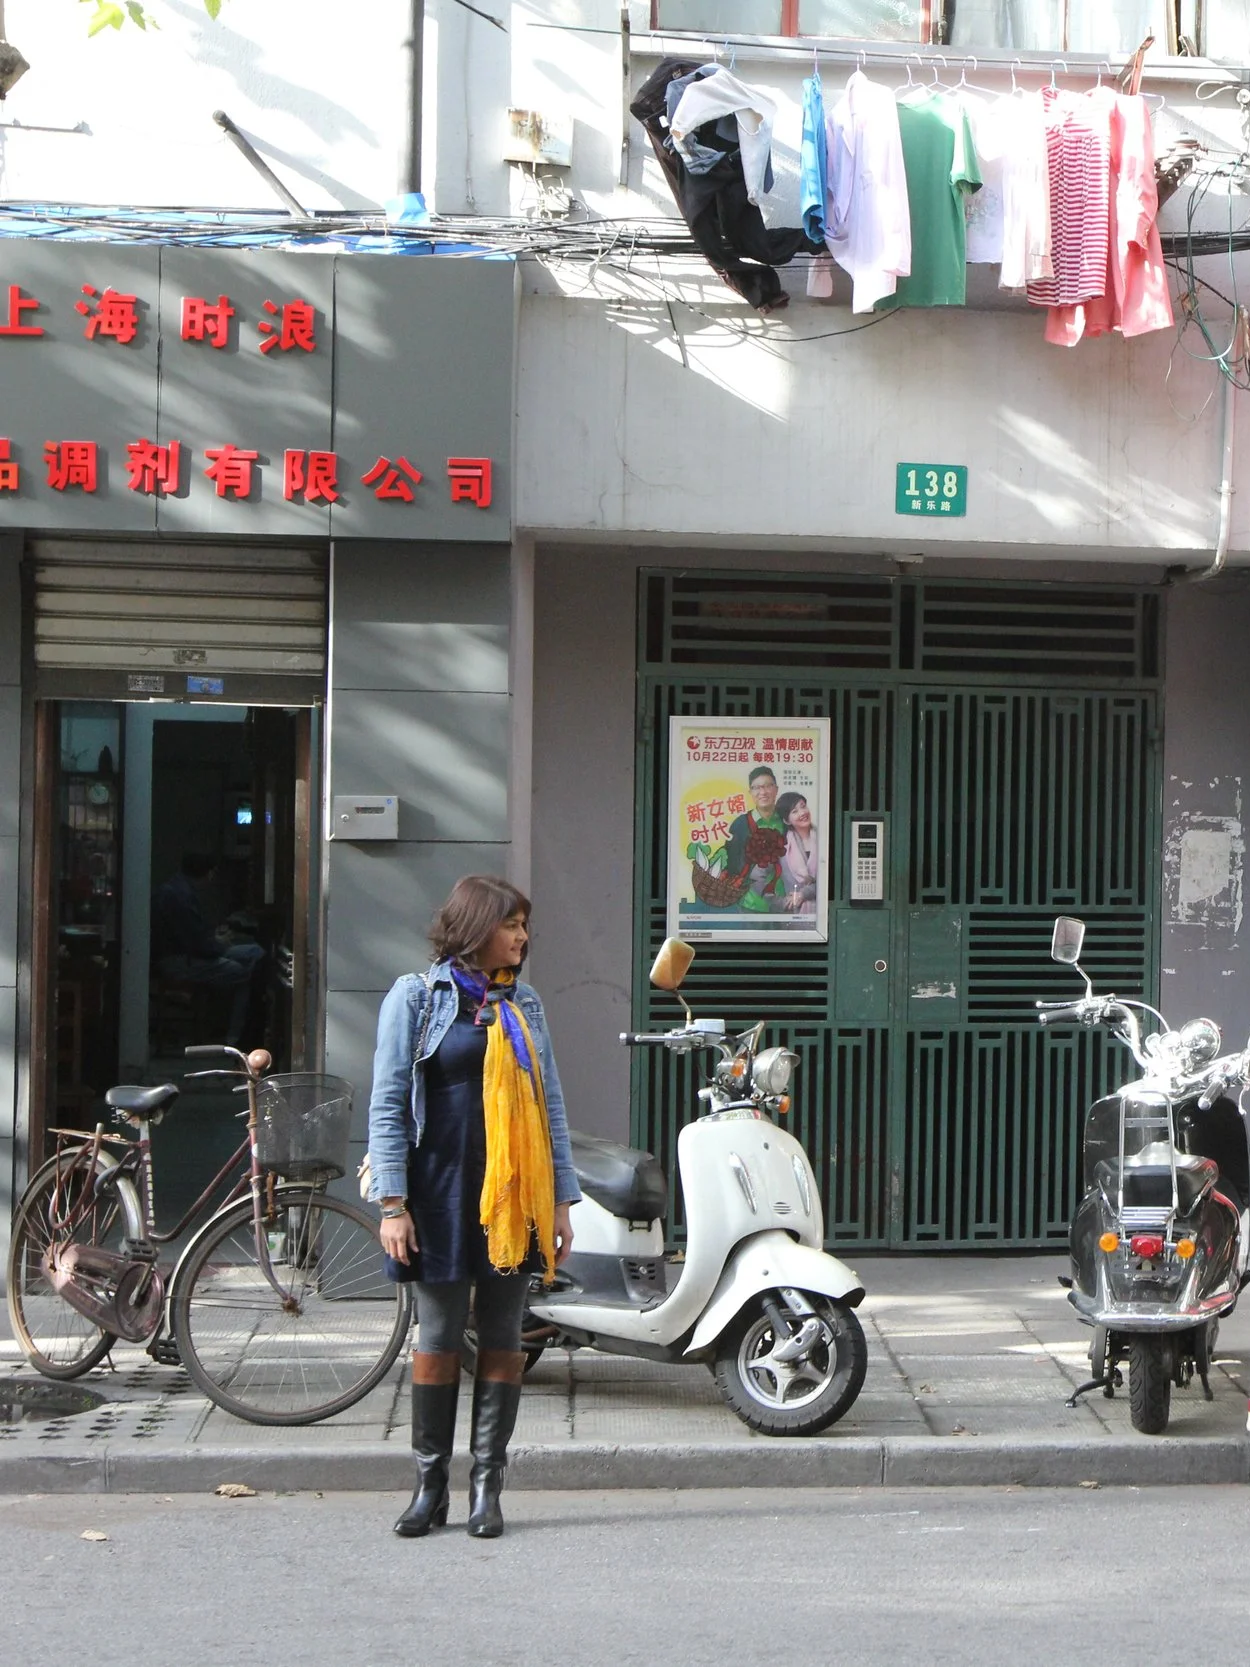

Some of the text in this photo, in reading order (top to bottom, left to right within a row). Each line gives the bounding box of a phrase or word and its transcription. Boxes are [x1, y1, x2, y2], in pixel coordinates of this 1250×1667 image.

[0, 283, 315, 353] 上海时浪
[905, 469, 957, 498] 138
[911, 499, 951, 512] 新乐路
[704, 736, 814, 751] 东方卫视 温情剧献
[686, 751, 814, 763] 10月22日起 每晚19:30
[686, 794, 747, 823] 新女婿
[691, 821, 731, 843] 时代
